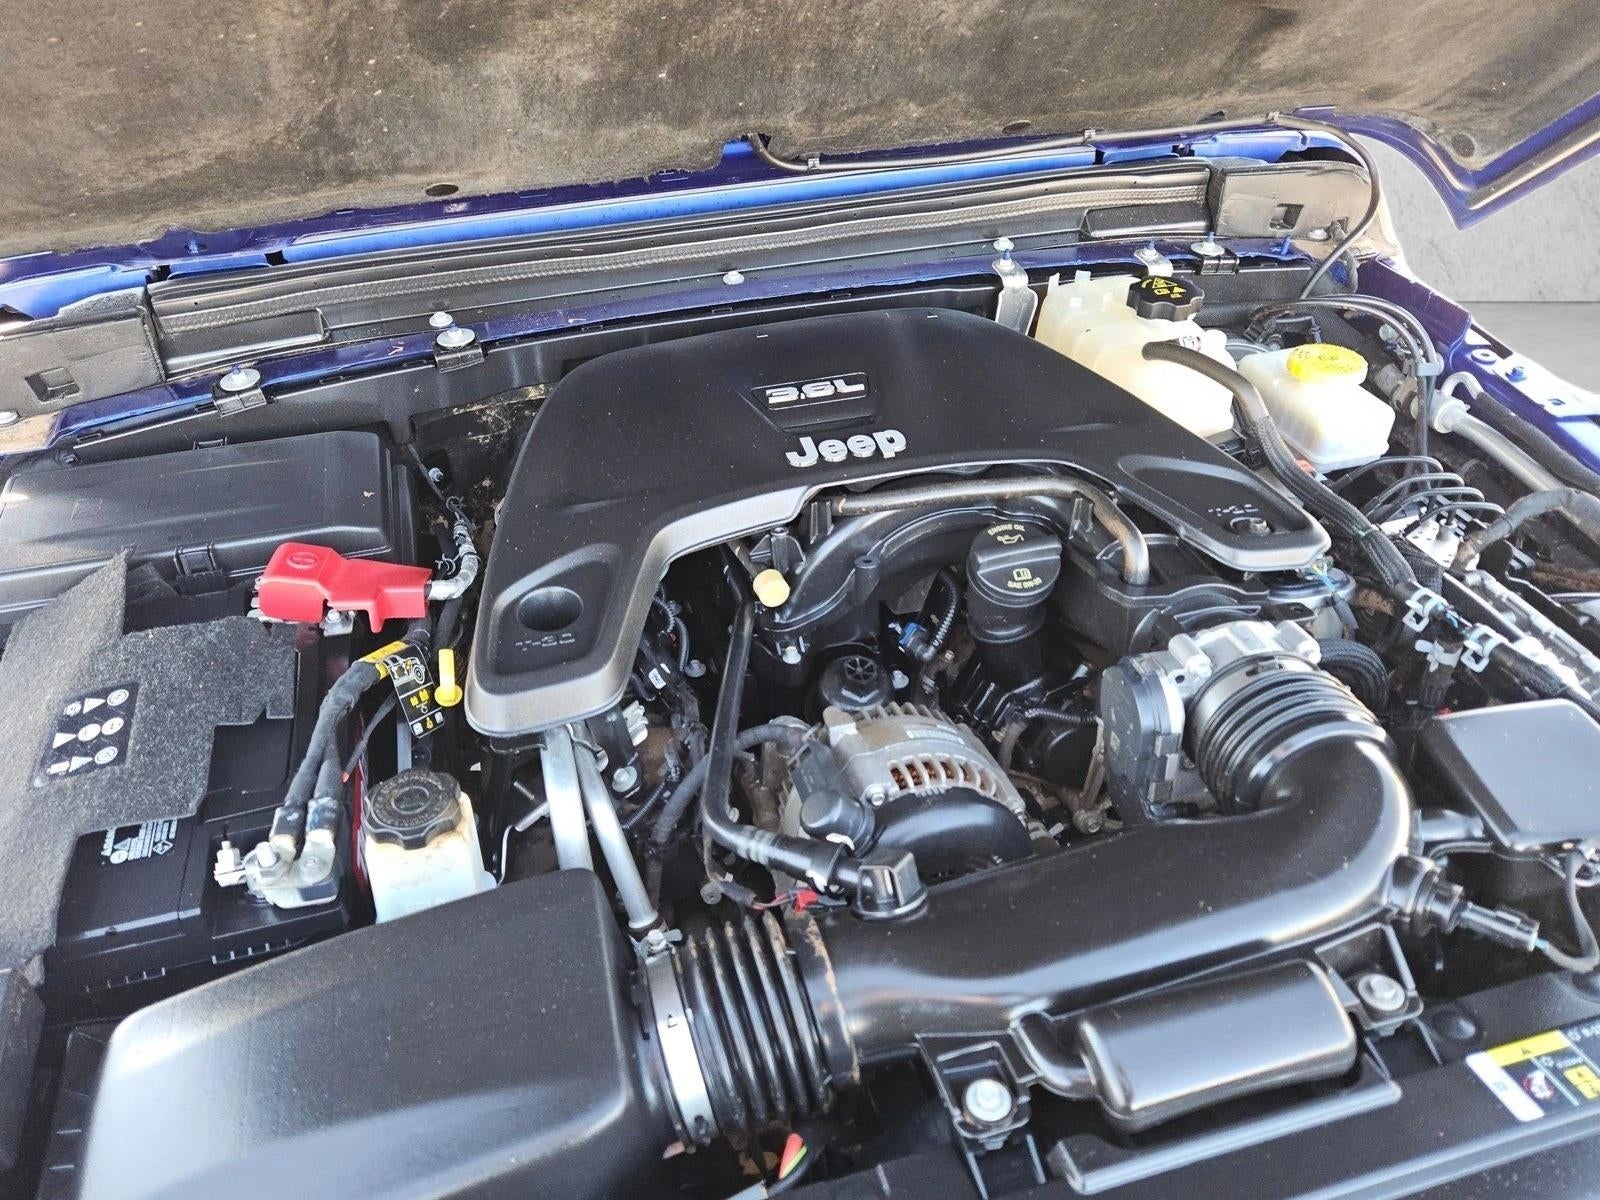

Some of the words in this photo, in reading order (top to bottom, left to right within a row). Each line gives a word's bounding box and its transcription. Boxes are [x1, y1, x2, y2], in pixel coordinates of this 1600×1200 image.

[785, 429, 907, 468] Jeep
[987, 524, 1013, 536] ENGINE
[1013, 524, 1026, 532] OIL
